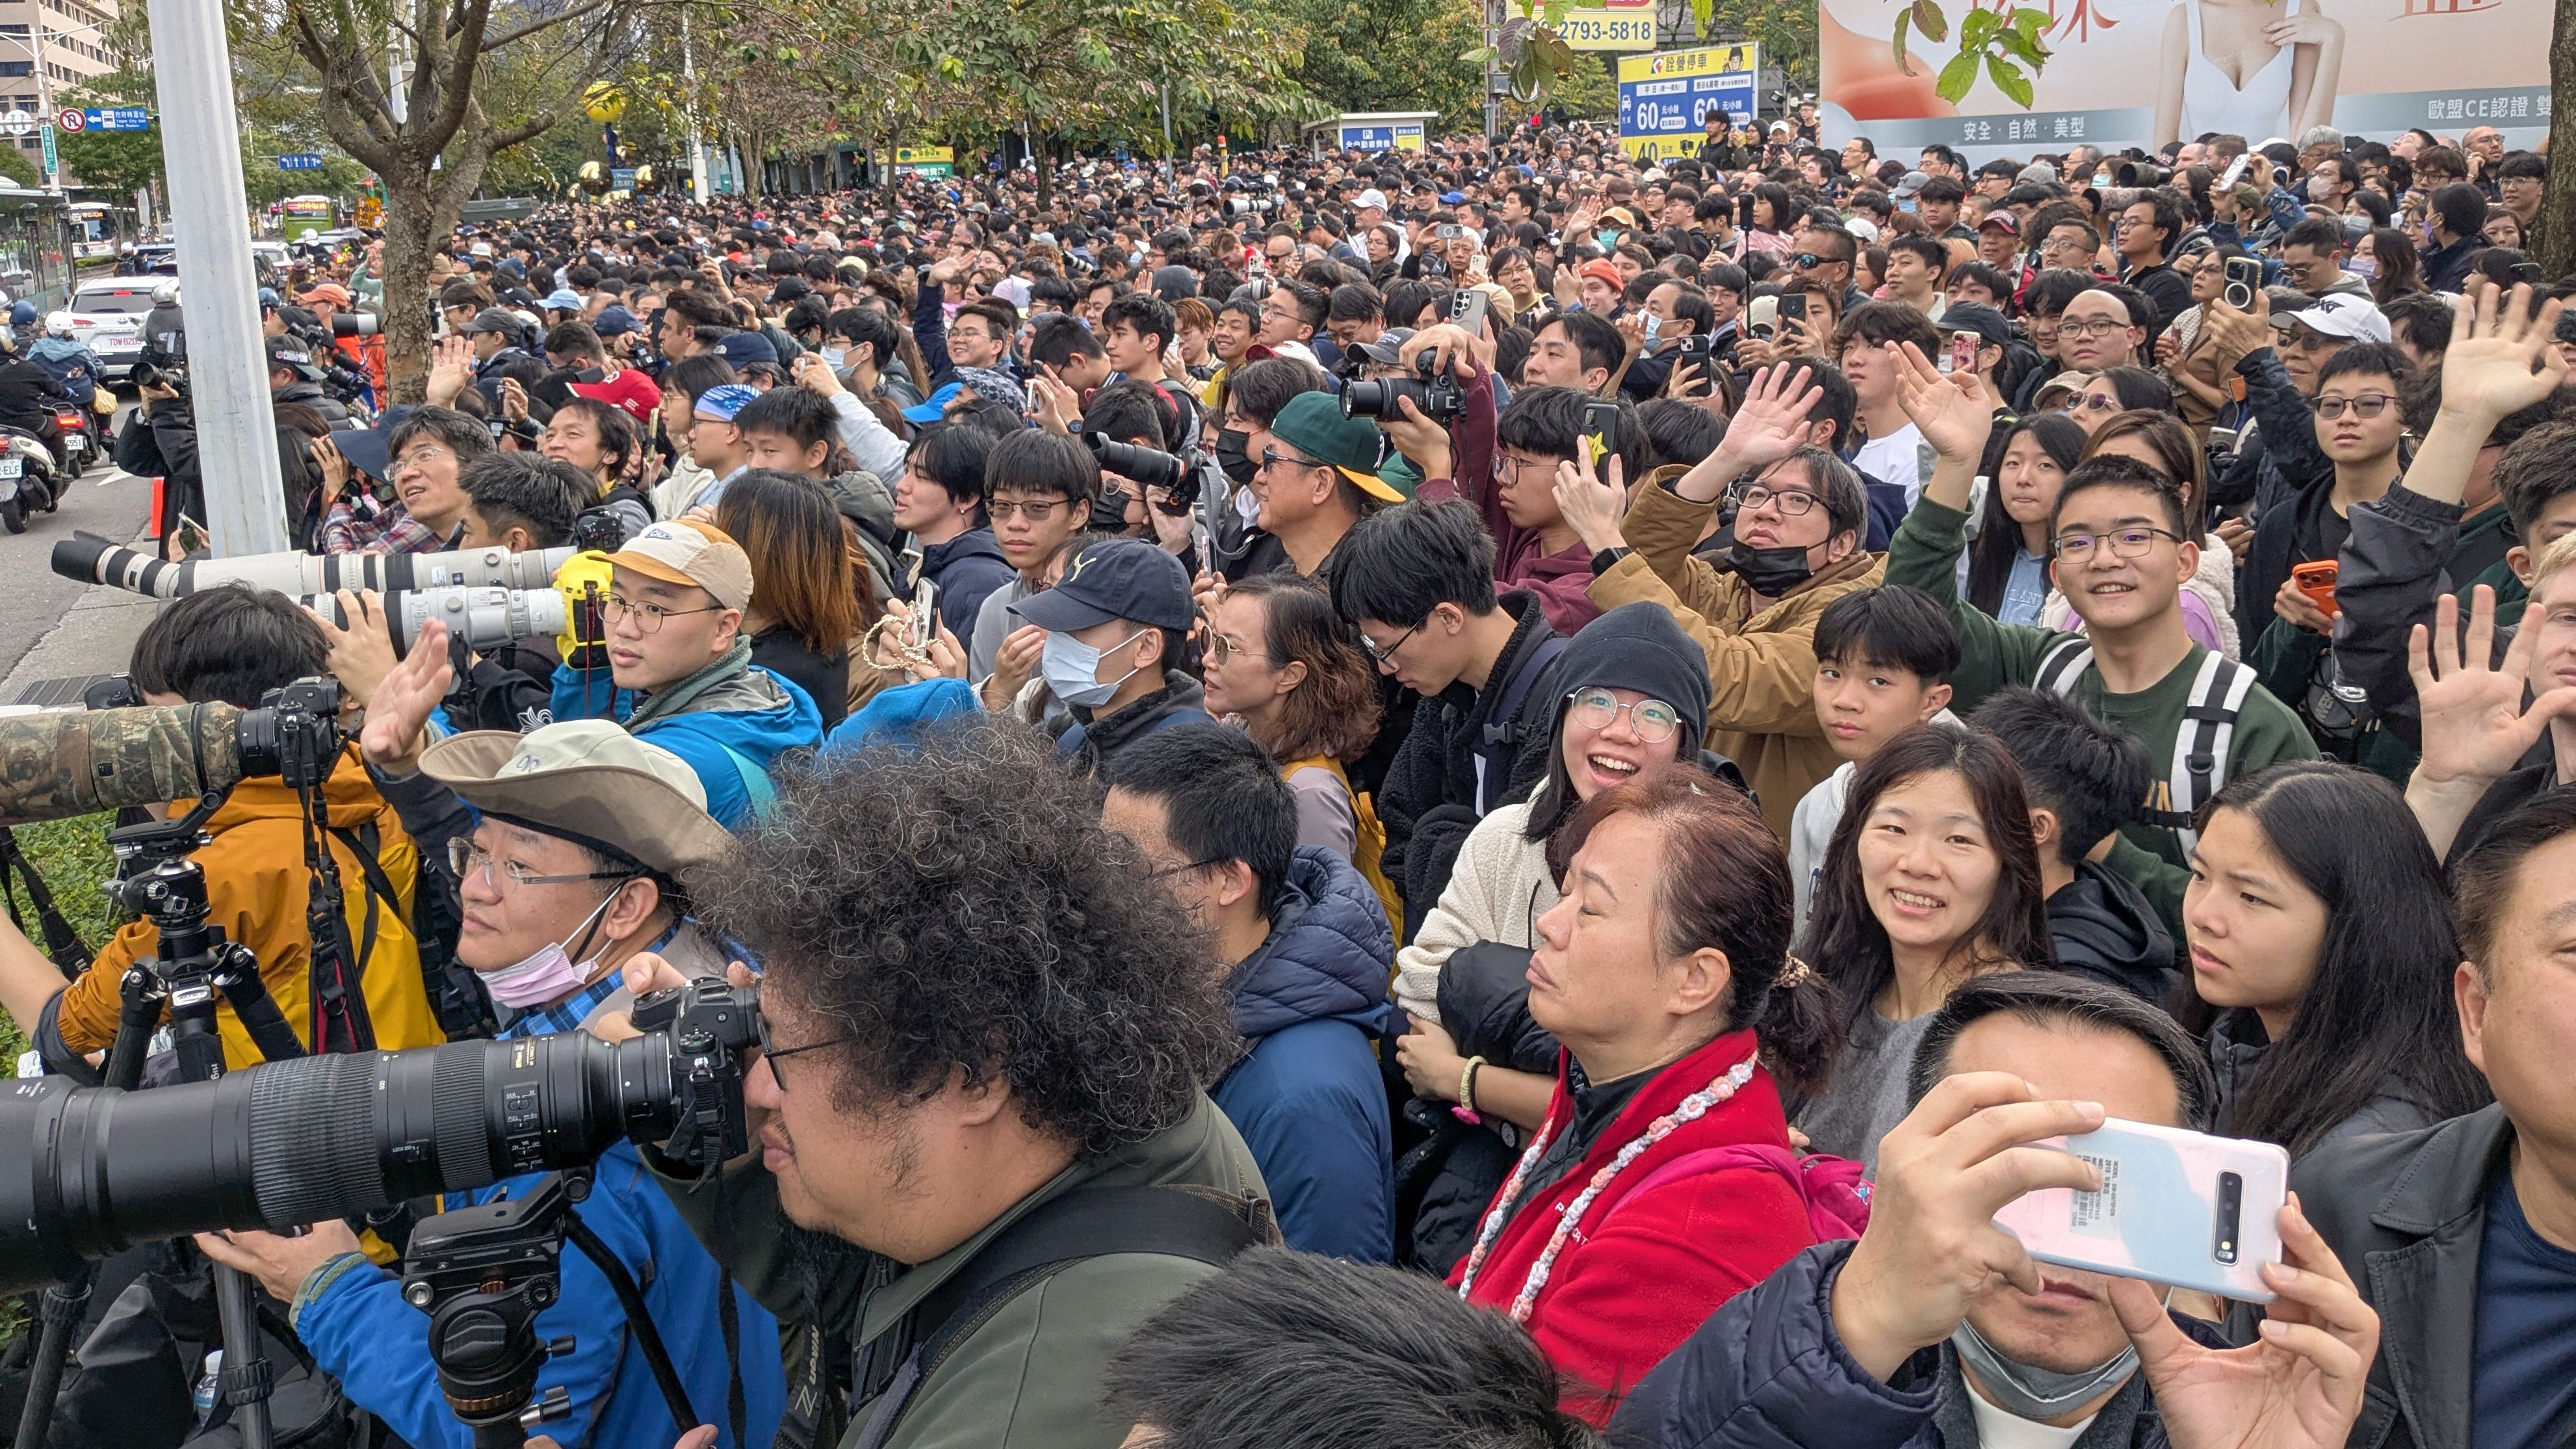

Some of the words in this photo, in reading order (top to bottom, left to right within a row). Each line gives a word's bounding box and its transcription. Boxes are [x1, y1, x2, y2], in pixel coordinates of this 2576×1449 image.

[1528, 21, 1651, 41] -2793-5818
[1637, 101, 1658, 131] 60
[2428, 96, 2529, 120] 歐盟CE認證
[2536, 94, 2553, 117] 雙
[1964, 120, 1991, 141] 安全
[2009, 118, 2036, 140] 自然
[2054, 116, 2085, 138] 美型
[0, 465, 20, 476] -ELF
